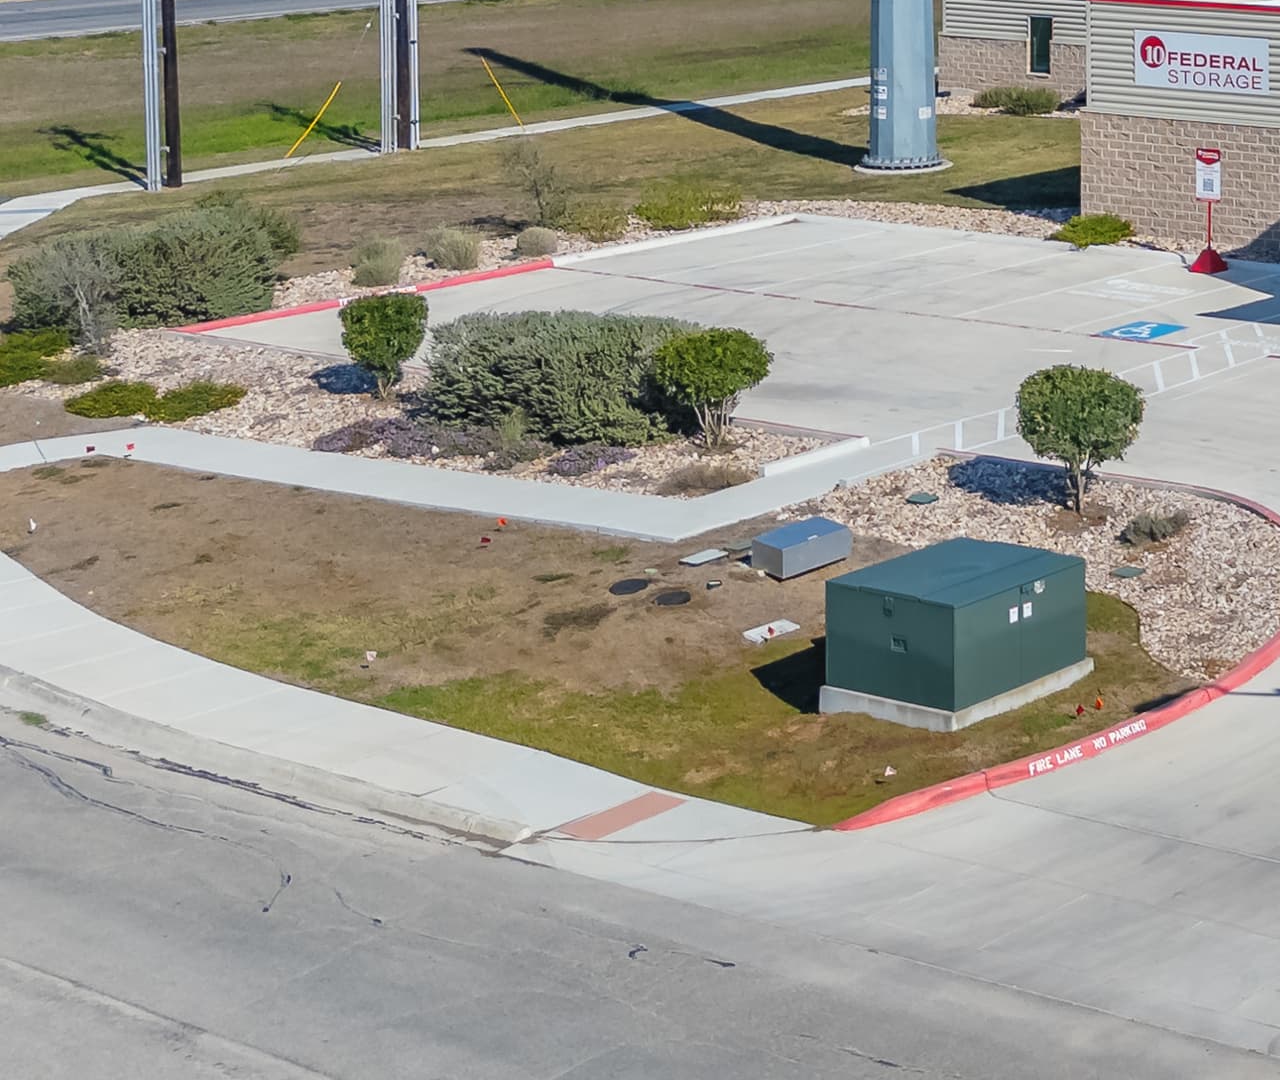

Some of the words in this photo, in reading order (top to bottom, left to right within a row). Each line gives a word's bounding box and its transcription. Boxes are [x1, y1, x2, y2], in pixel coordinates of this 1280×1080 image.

[1144, 45, 1164, 65] 10
[1167, 51, 1264, 72] FEDERAL
[1167, 69, 1263, 90] STORAGE
[1028, 756, 1054, 776] FIRE
[1055, 745, 1083, 764] LANE
